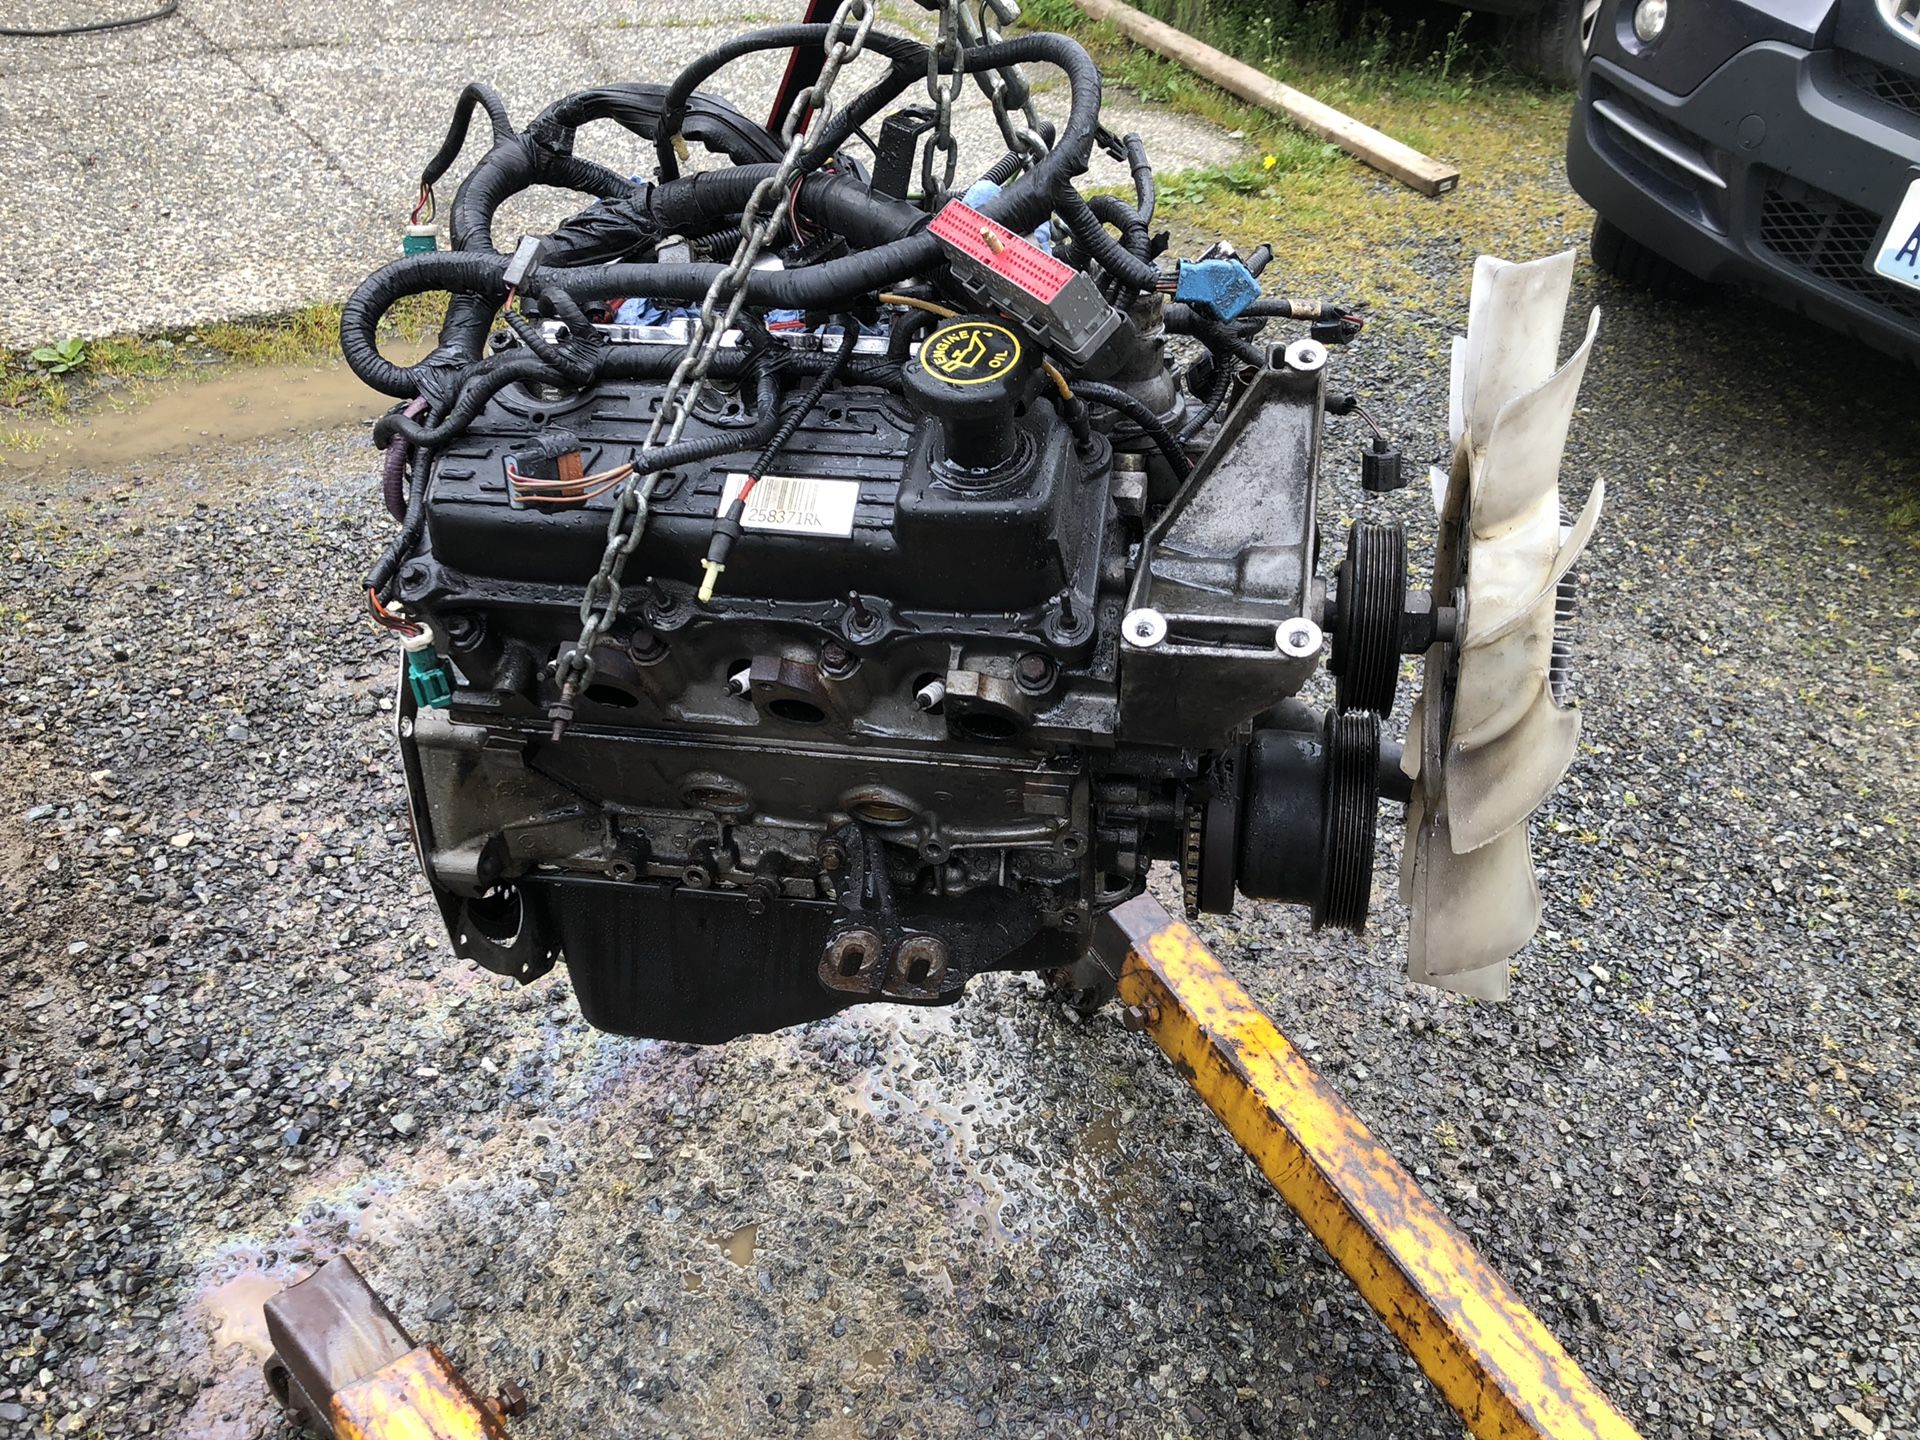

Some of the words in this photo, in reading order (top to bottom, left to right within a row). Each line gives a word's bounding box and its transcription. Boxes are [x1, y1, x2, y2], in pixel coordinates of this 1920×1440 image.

[933, 330, 970, 366] ENGINE
[988, 350, 1010, 368] OIL
[748, 508, 823, 527] 258371RK
